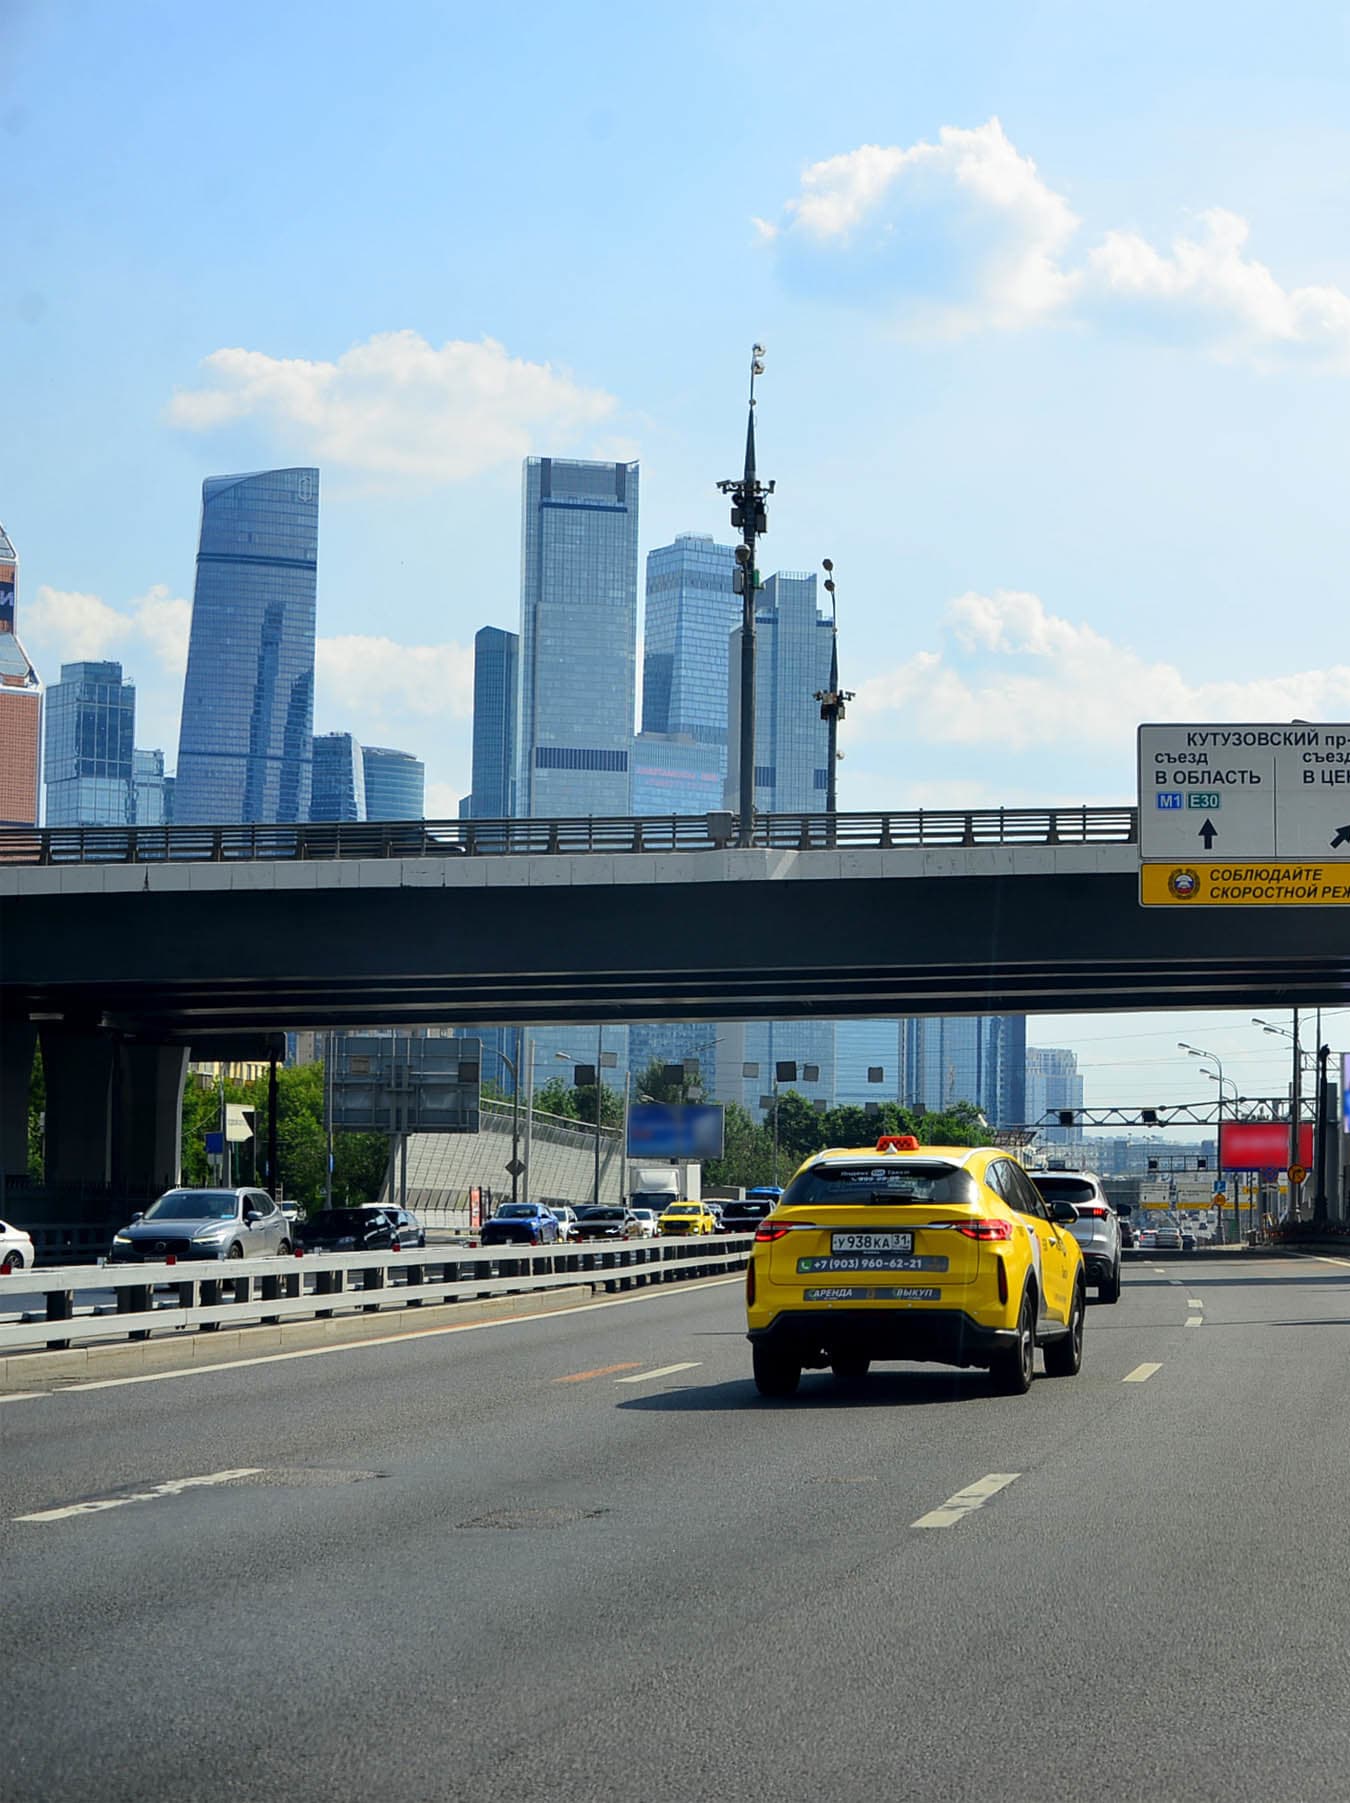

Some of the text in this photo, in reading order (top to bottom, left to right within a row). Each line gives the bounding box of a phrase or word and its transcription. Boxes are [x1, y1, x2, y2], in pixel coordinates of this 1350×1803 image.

[1186, 729, 1319, 747] КУТУЗОВСКИЙ
[1154, 752, 1208, 766] съезд
[1155, 770, 1261, 785] В ОБЛАСТЬ
[1303, 770, 1315, 784] В
[1189, 794, 1219, 808] E30
[1209, 868, 1323, 883] СОБЛЮДАЙТЕ
[1209, 884, 1320, 899] СКОРОСТНОЙ
[814, 1258, 922, 1270] +7 (903) 960-62-21
[813, 1288, 853, 1298] АРЕНДА
